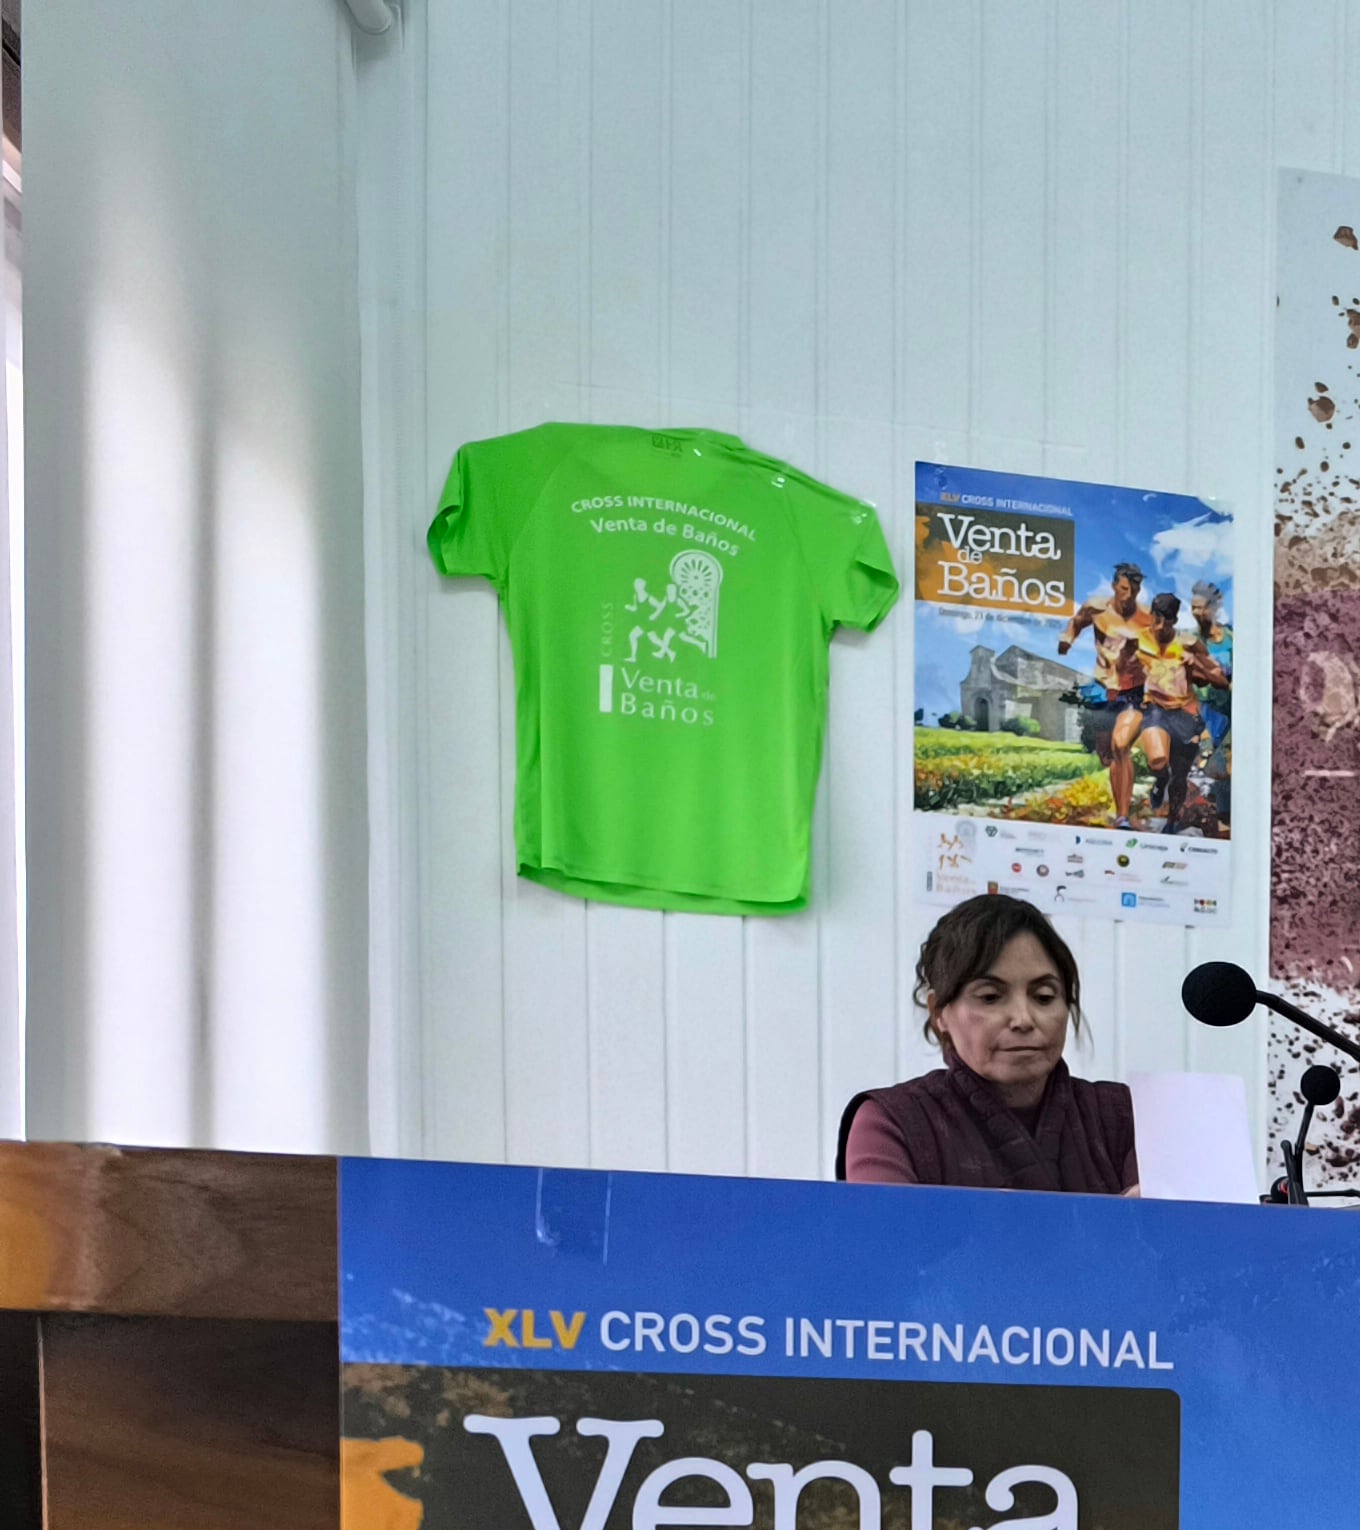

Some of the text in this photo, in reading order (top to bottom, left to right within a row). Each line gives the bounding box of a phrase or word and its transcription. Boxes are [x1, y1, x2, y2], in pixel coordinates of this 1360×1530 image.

[571, 495, 756, 542] CROSS INTERNACIONAL
[590, 517, 740, 557] Venta de Baños
[937, 513, 1062, 560] Venta
[957, 546, 983, 565] de
[937, 560, 1066, 608] Baños
[601, 601, 614, 657] CROSS
[621, 667, 699, 700] Venta
[621, 692, 714, 726] Baños
[482, 1307, 1175, 1371] XLV CROSS INTERNACIONAL
